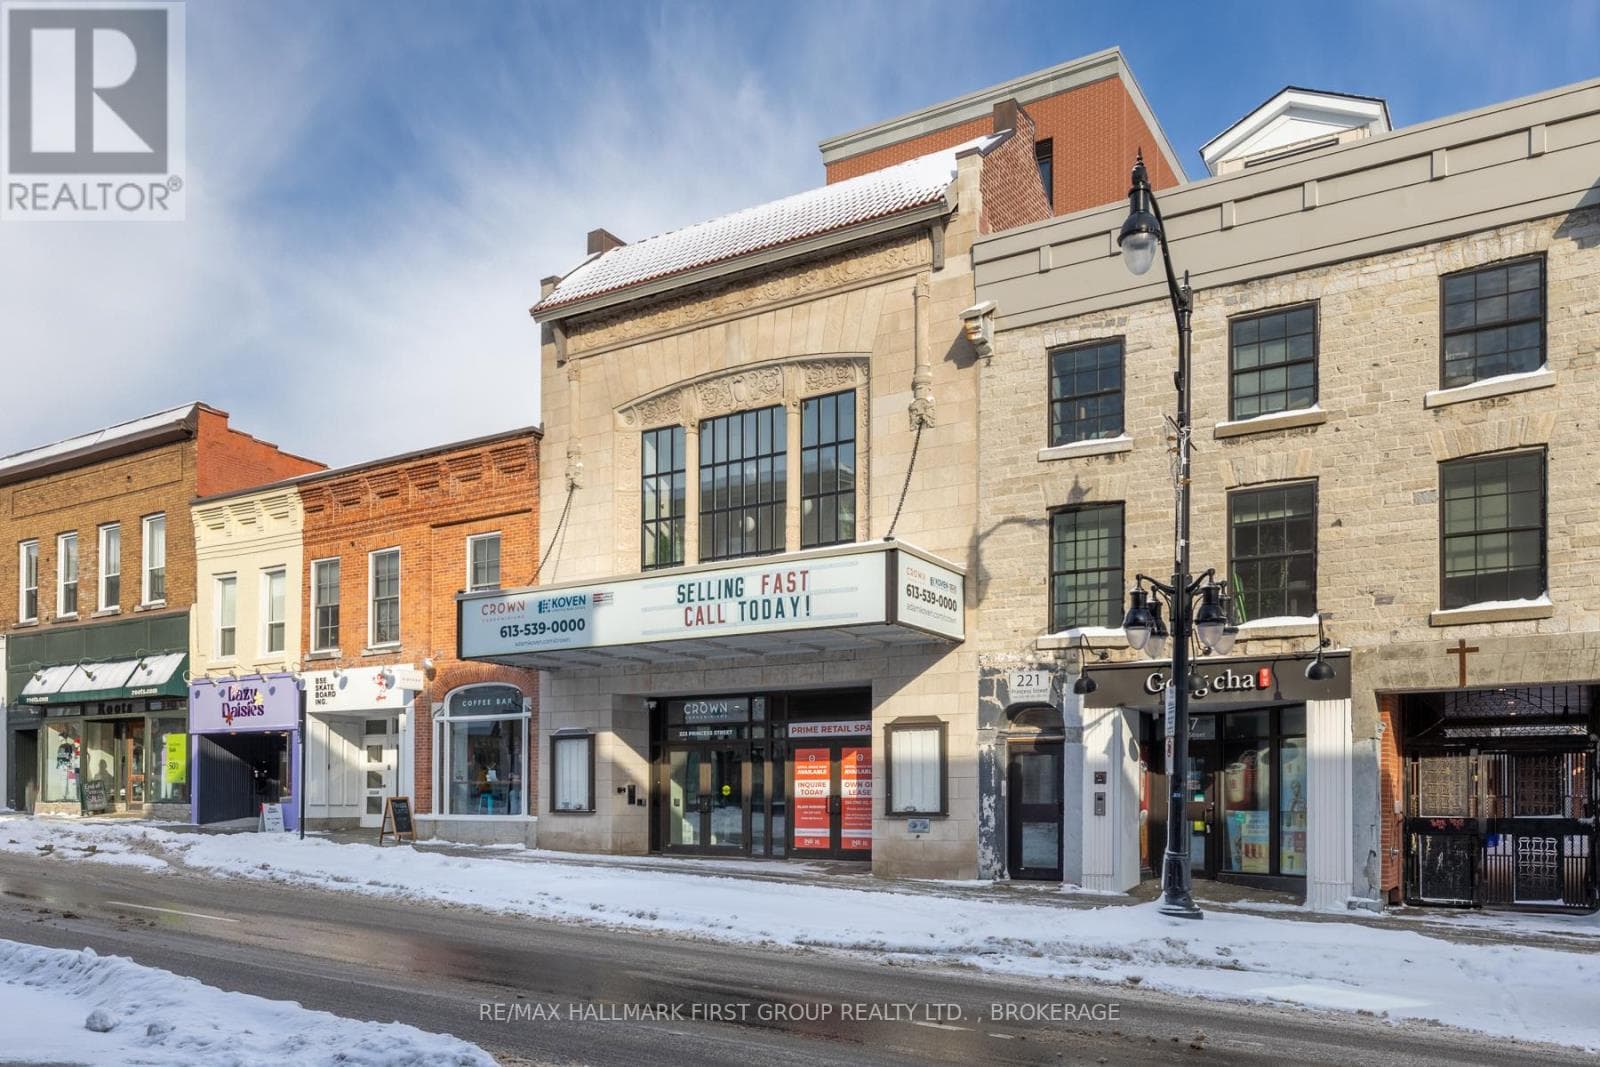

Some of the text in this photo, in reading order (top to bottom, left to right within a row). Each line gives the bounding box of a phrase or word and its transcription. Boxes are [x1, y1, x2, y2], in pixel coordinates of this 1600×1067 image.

[677, 570, 809, 604] SELLING FAST
[551, 594, 587, 609] KOVEN
[906, 583, 958, 612] 613-539-0000
[481, 600, 526, 616] CROWN
[684, 595, 811, 627] CALL TODAY!
[500, 618, 586, 638] 613-539-0000
[1017, 674, 1040, 687] 221
[1213, 668, 1256, 690] cha
[315, 683, 335, 691] SKATE
[228, 686, 258, 705] Lazy
[315, 691, 337, 699] BOARD
[462, 697, 513, 707] COFFEE BAR
[98, 702, 133, 715] Roots
[221, 702, 265, 718] Daisies
[683, 702, 728, 715] CROWN
[791, 725, 819, 735] PRIME
[822, 723, 851, 734] RETAIL
